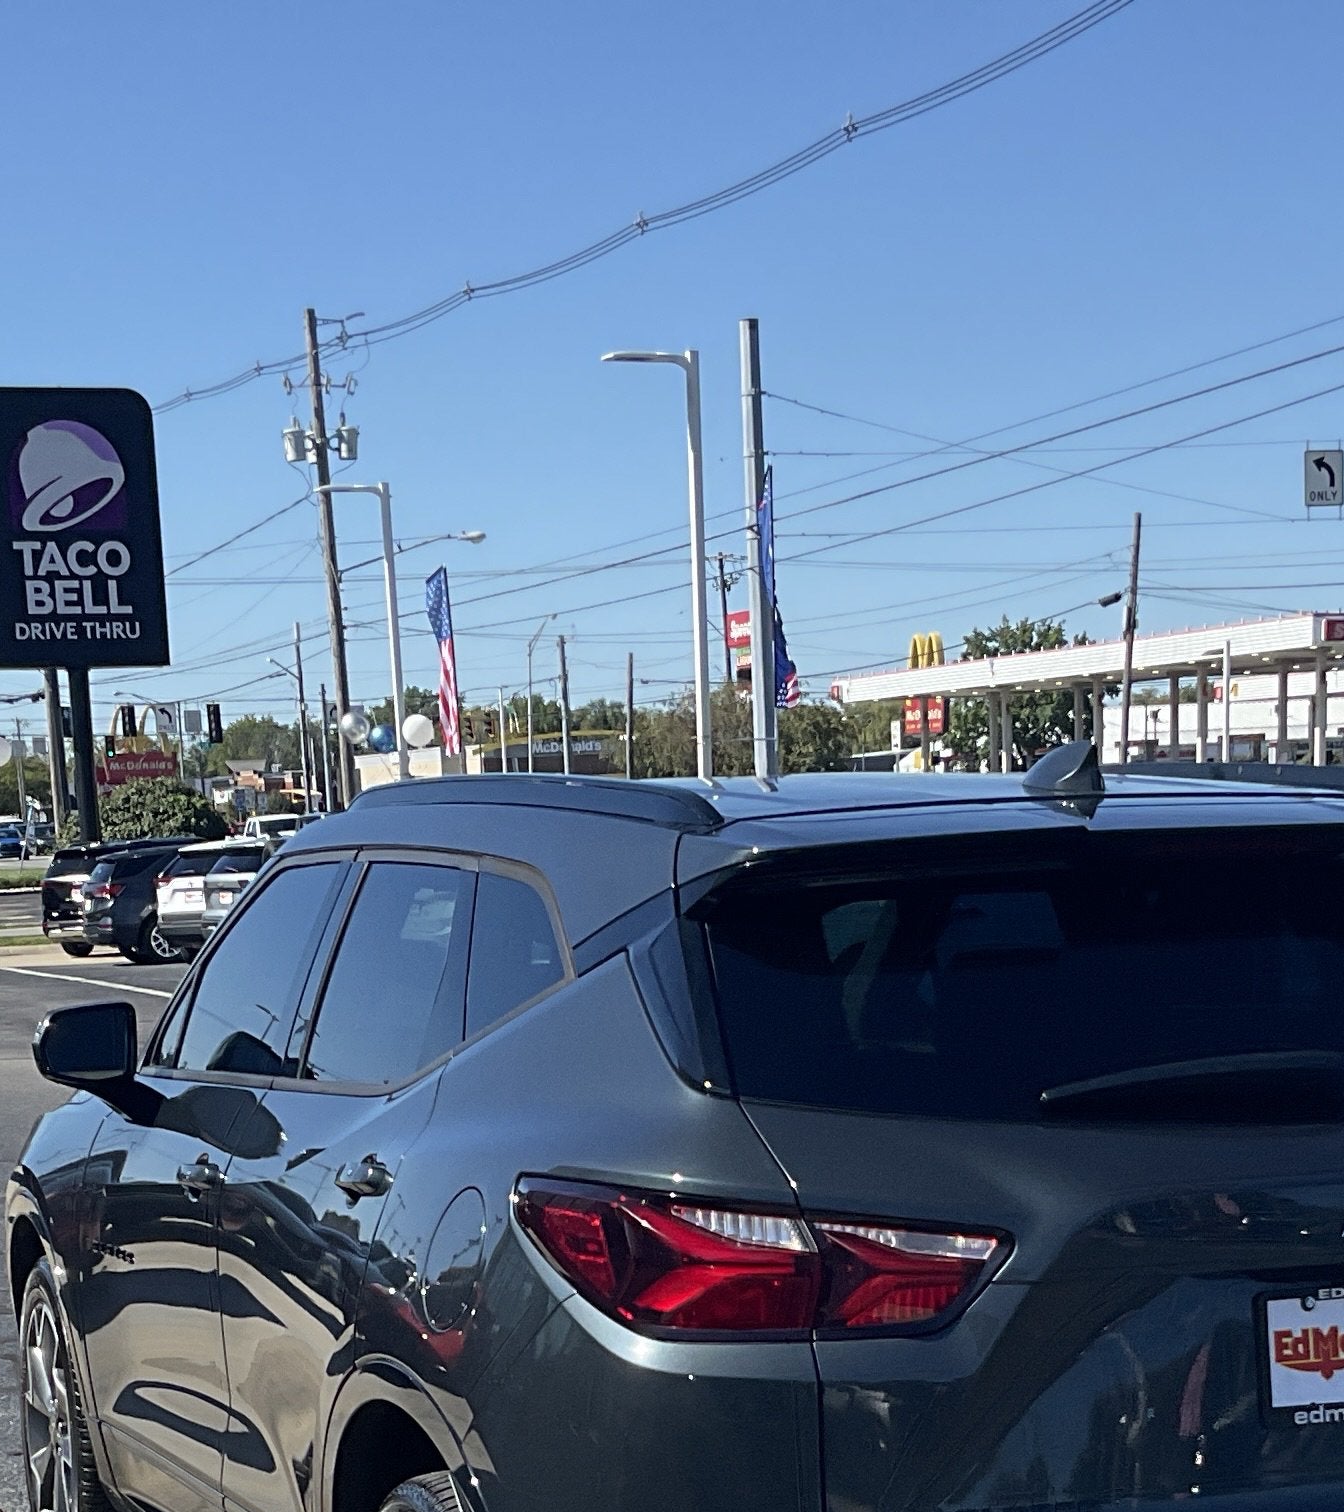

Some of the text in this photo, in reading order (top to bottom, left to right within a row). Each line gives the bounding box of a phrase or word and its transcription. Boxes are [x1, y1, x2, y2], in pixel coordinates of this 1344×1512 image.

[1309, 490, 1338, 502] ONLY
[13, 540, 131, 576] TACO
[25, 579, 133, 614] BELL
[15, 621, 141, 640] DRIVE THRU
